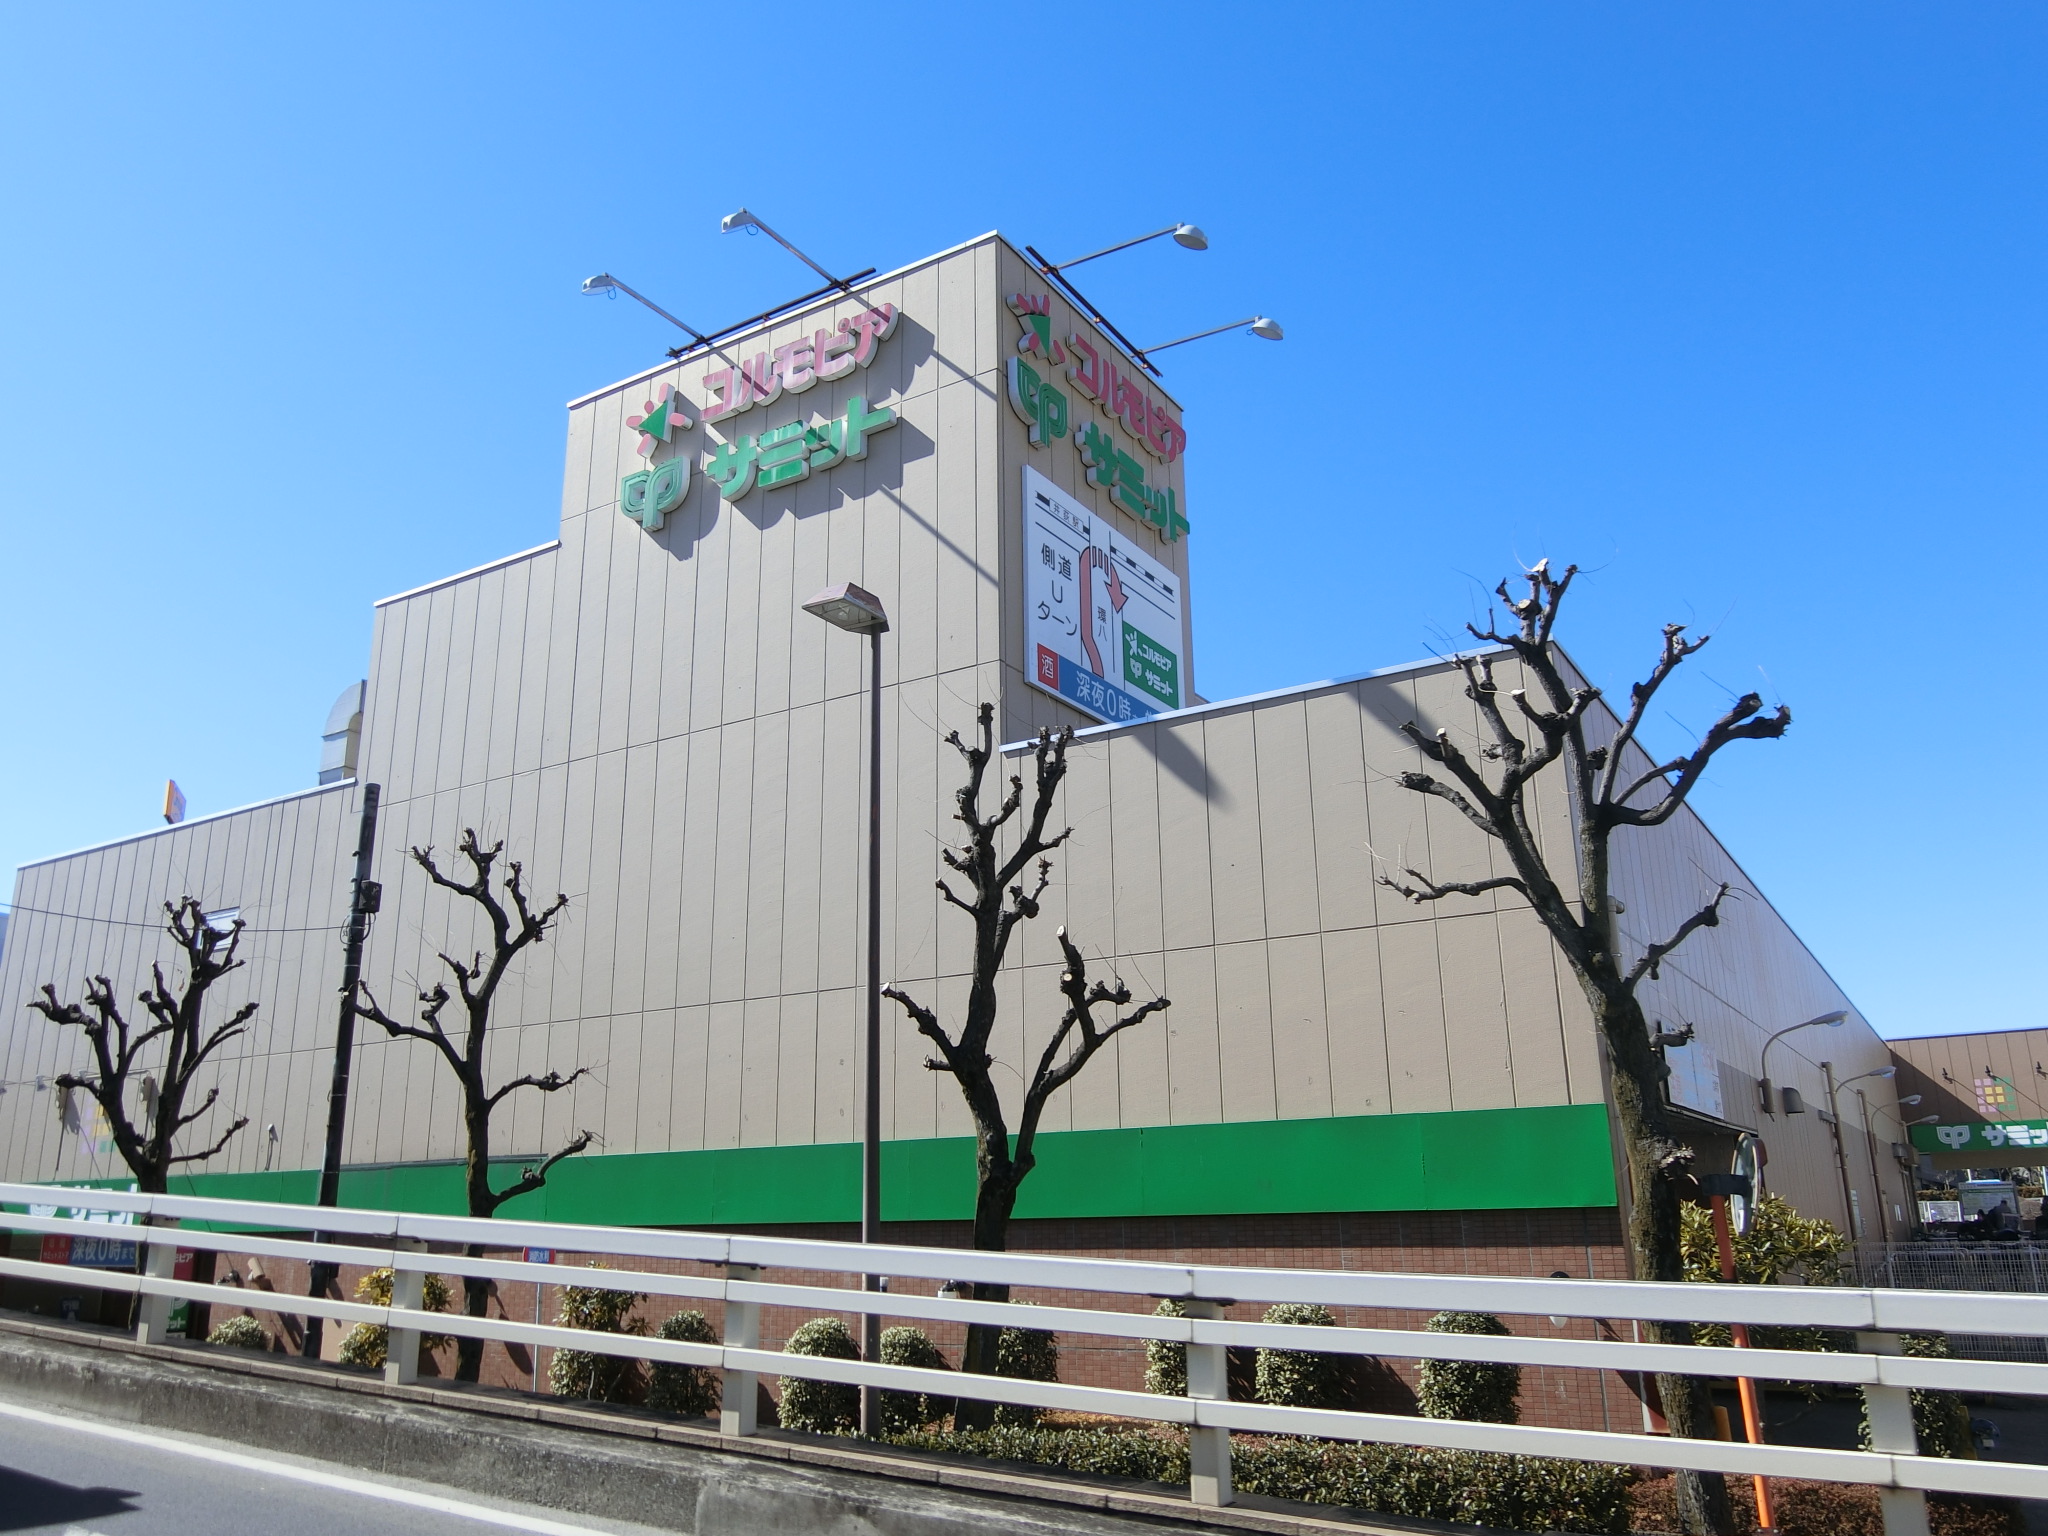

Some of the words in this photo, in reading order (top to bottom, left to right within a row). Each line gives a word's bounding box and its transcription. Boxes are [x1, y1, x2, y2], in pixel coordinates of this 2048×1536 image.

[701, 302, 899, 424] コルモピア
[1066, 333, 1186, 464] コルモピア
[707, 395, 898, 502] サミット
[1074, 421, 1190, 545] サミット
[1041, 543, 1073, 582] 側道
[1037, 600, 1077, 636] ターン
[1041, 653, 1054, 679] 酒
[1142, 643, 1172, 672] コルモピア
[1076, 670, 1138, 721] 深夜0時
[1145, 669, 1173, 696] サミット
[1981, 1122, 2048, 1146] サミッ
